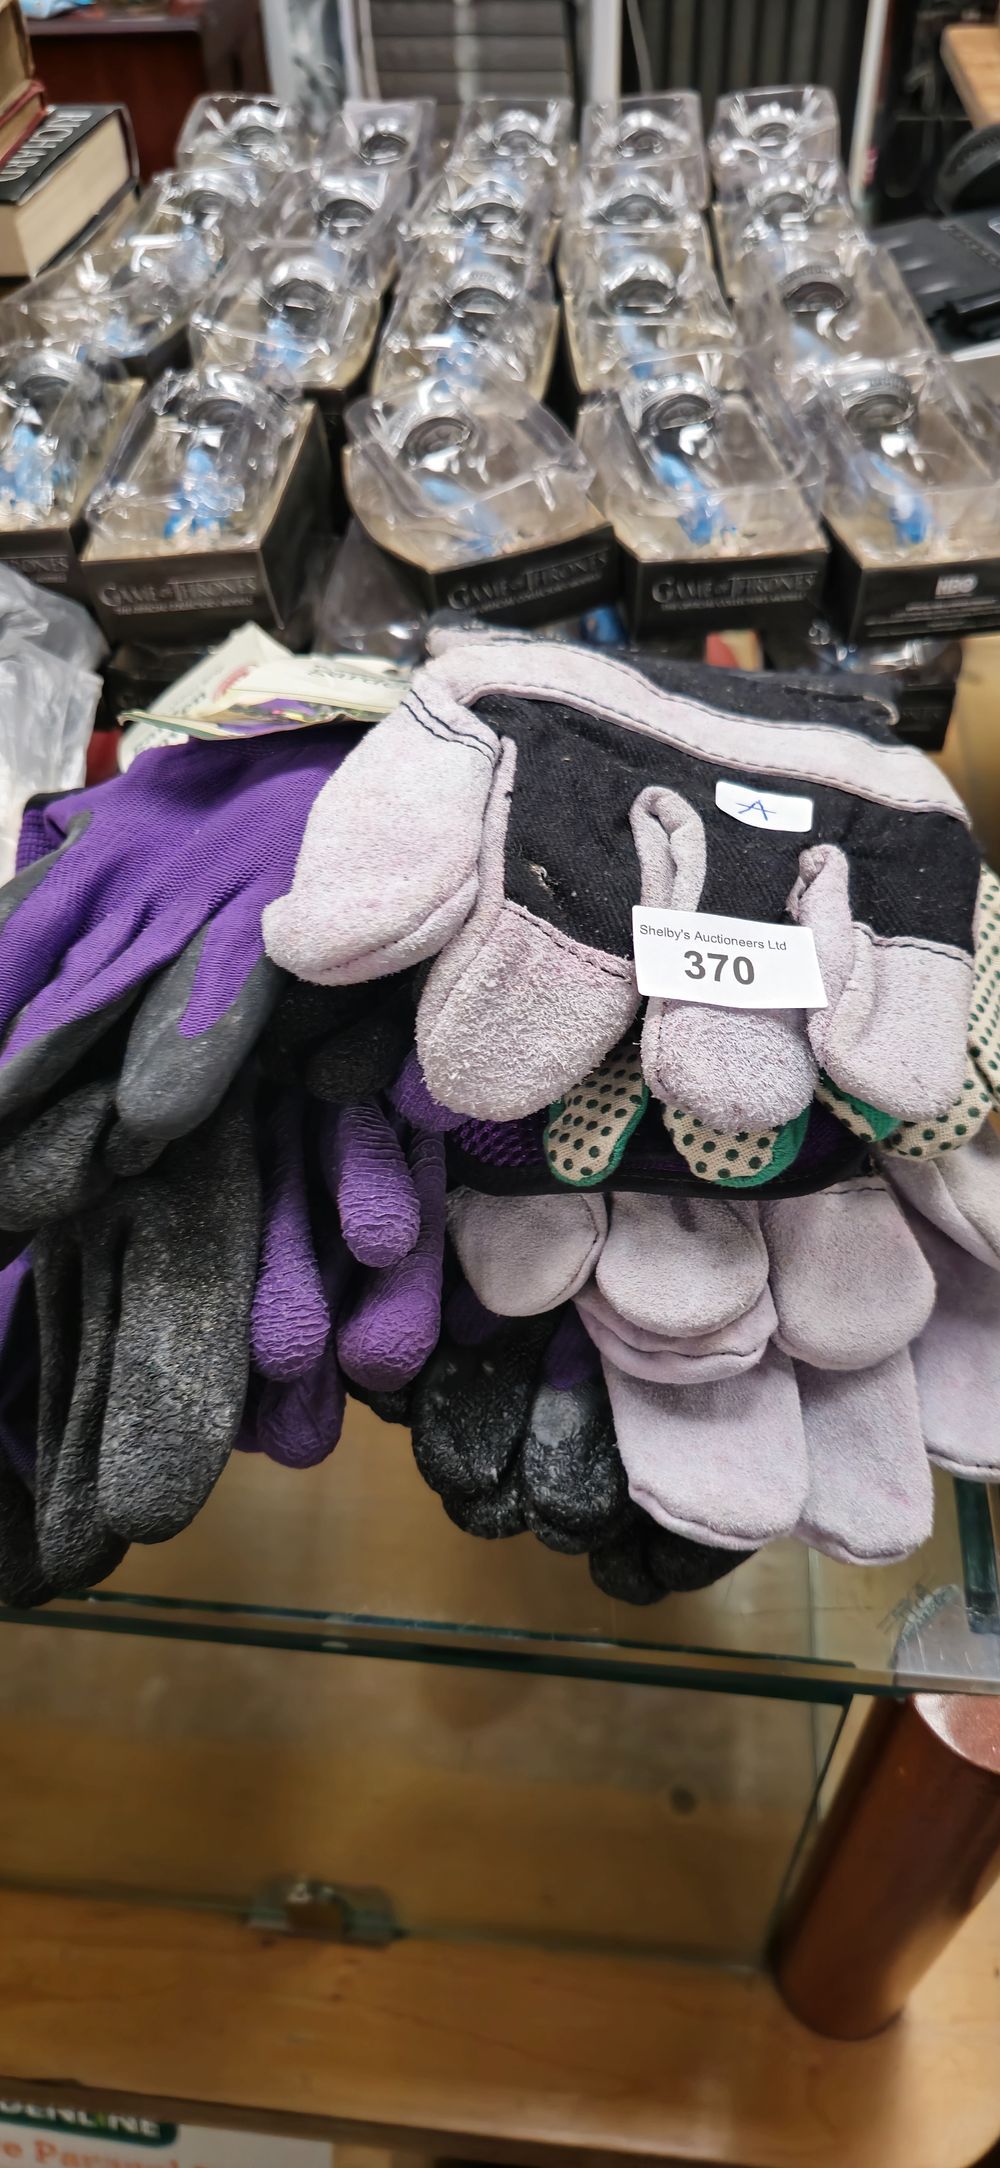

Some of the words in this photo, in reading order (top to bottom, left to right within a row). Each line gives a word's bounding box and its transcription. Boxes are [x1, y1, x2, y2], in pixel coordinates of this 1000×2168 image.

[0, 110, 92, 182] RICHARD
[639, 923, 691, 941] Shelby's
[694, 931, 765, 950] Auctioneers
[768, 939, 787, 951] Ltd
[684, 950, 756, 986] 370
